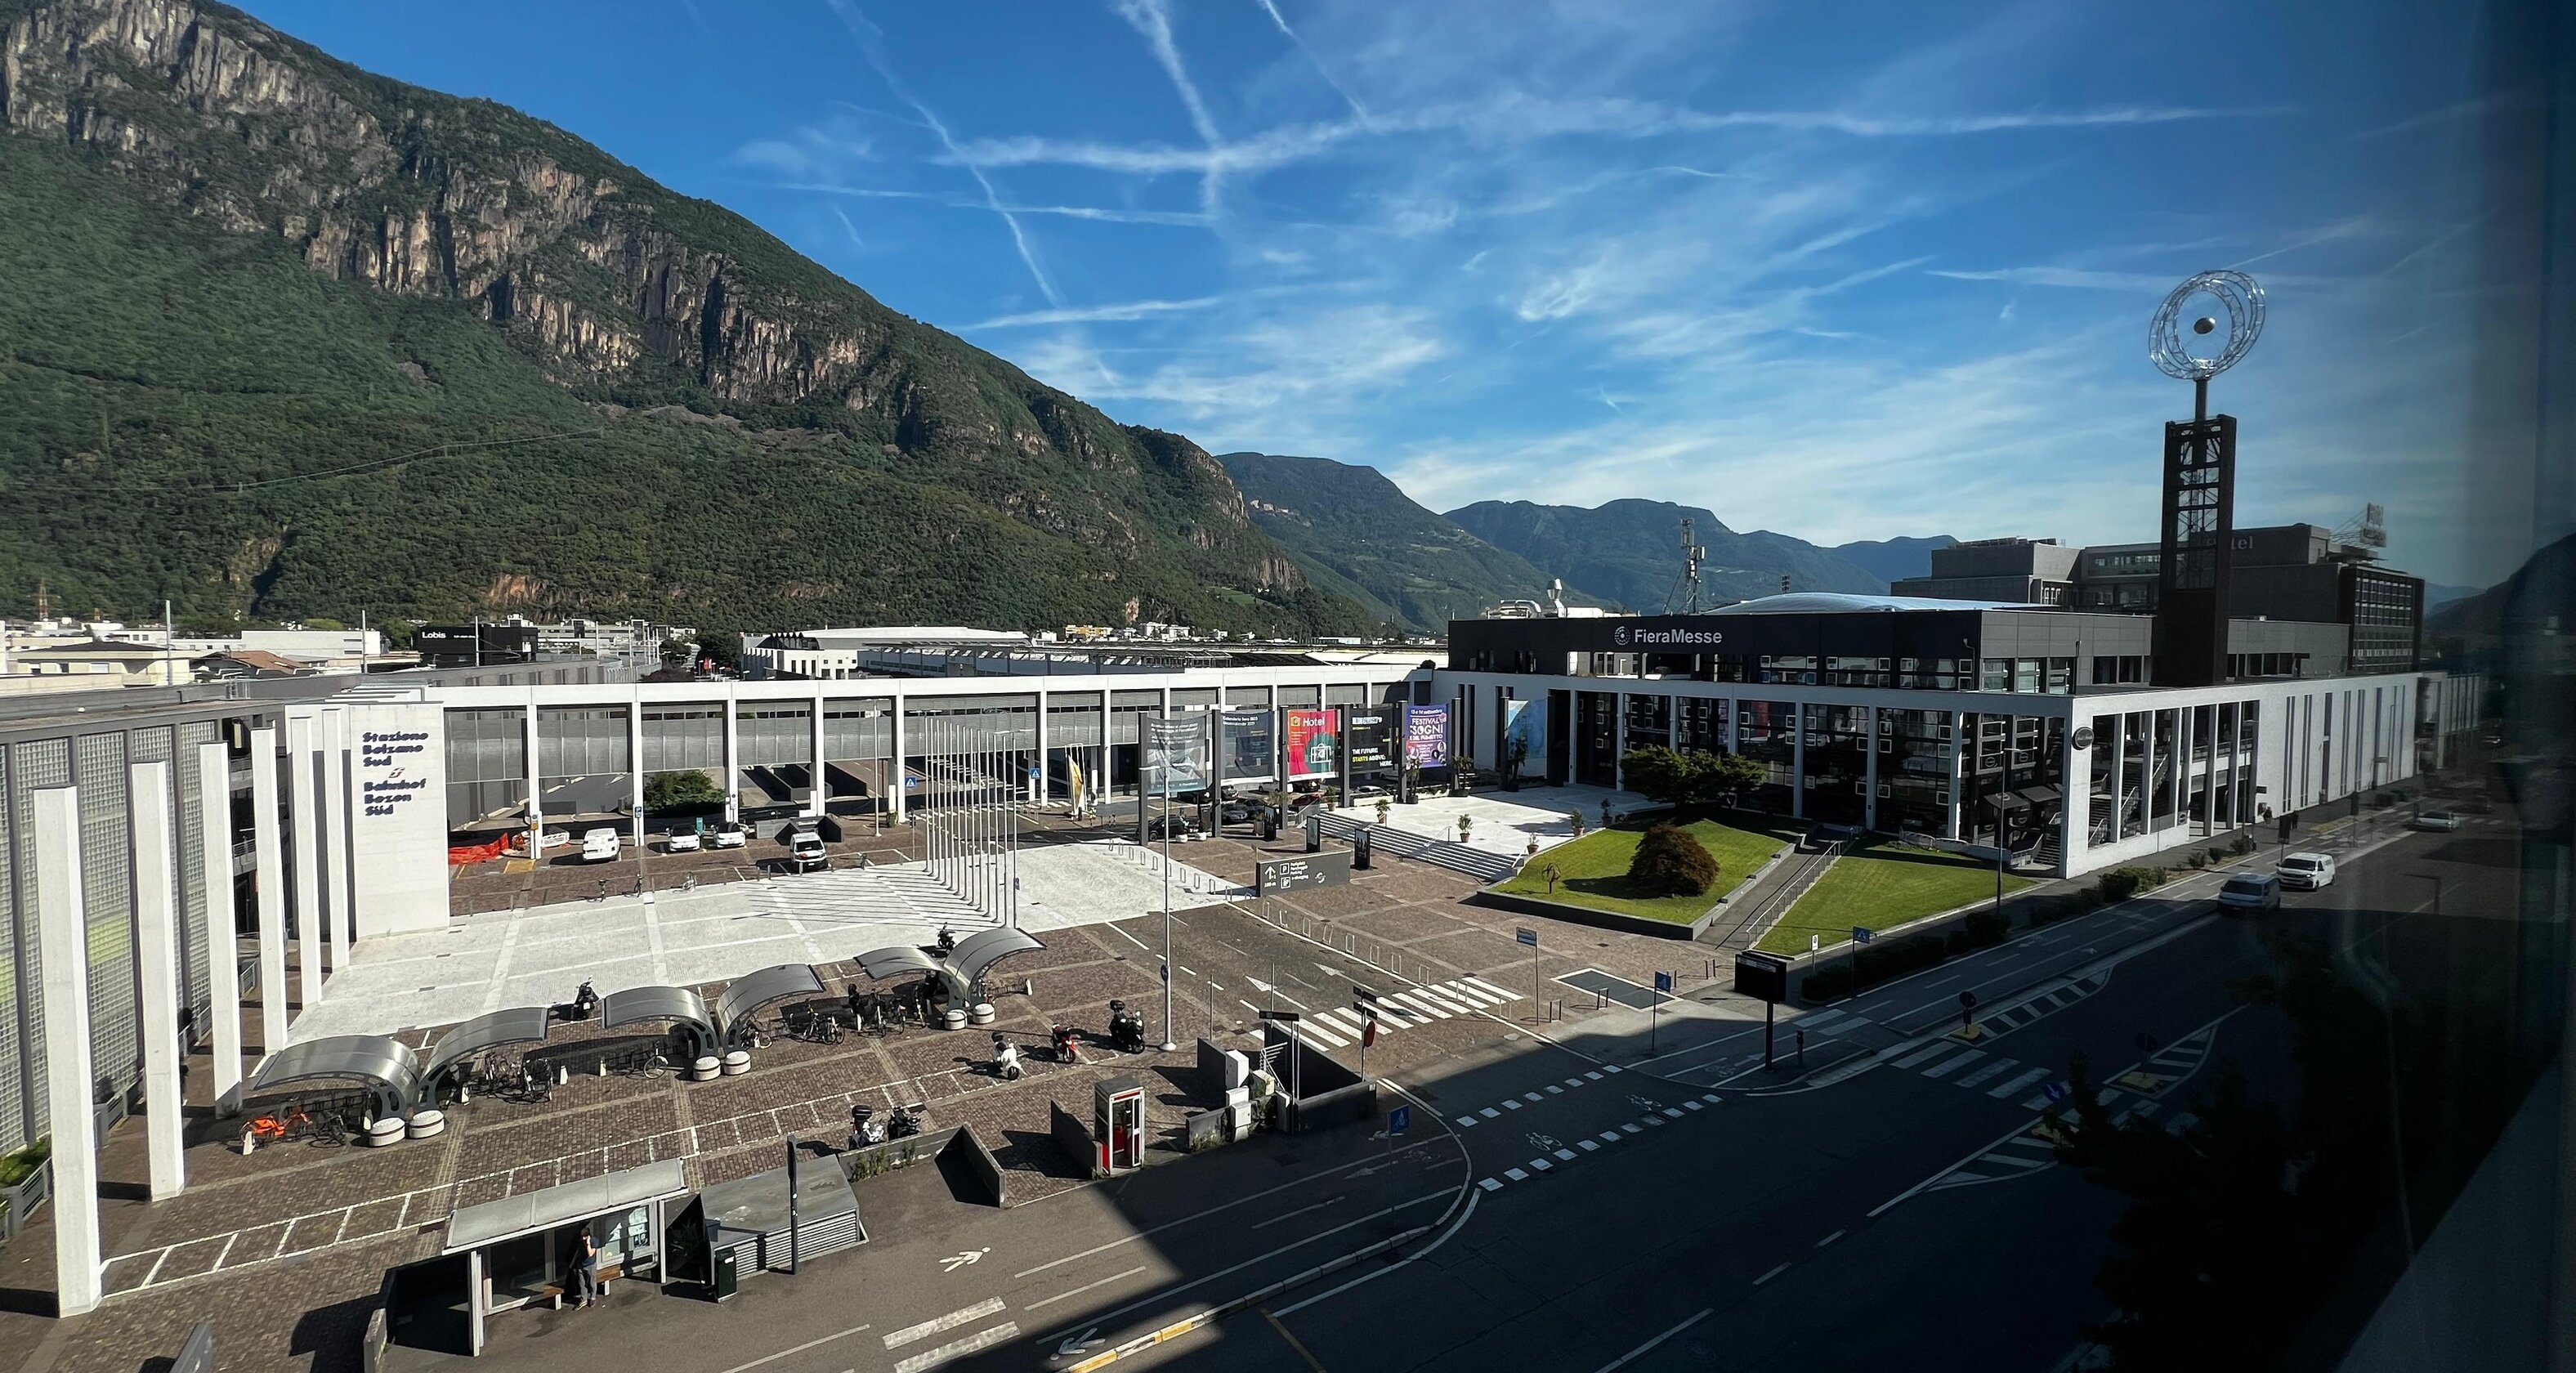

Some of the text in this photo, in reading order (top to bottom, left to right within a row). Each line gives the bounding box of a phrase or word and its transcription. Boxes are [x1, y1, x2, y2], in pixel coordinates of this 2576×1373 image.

[1635, 629, 1722, 643] FieraMesse
[1303, 717, 1326, 727] Hotel
[1412, 724, 1443, 735] SOGNI
[362, 731, 429, 742] Stazione
[362, 744, 424, 755] Bolzano
[363, 756, 391, 767] Sud
[364, 778, 427, 792] Bahnhof
[364, 794, 412, 804] Bozen
[365, 804, 394, 816] Süd
